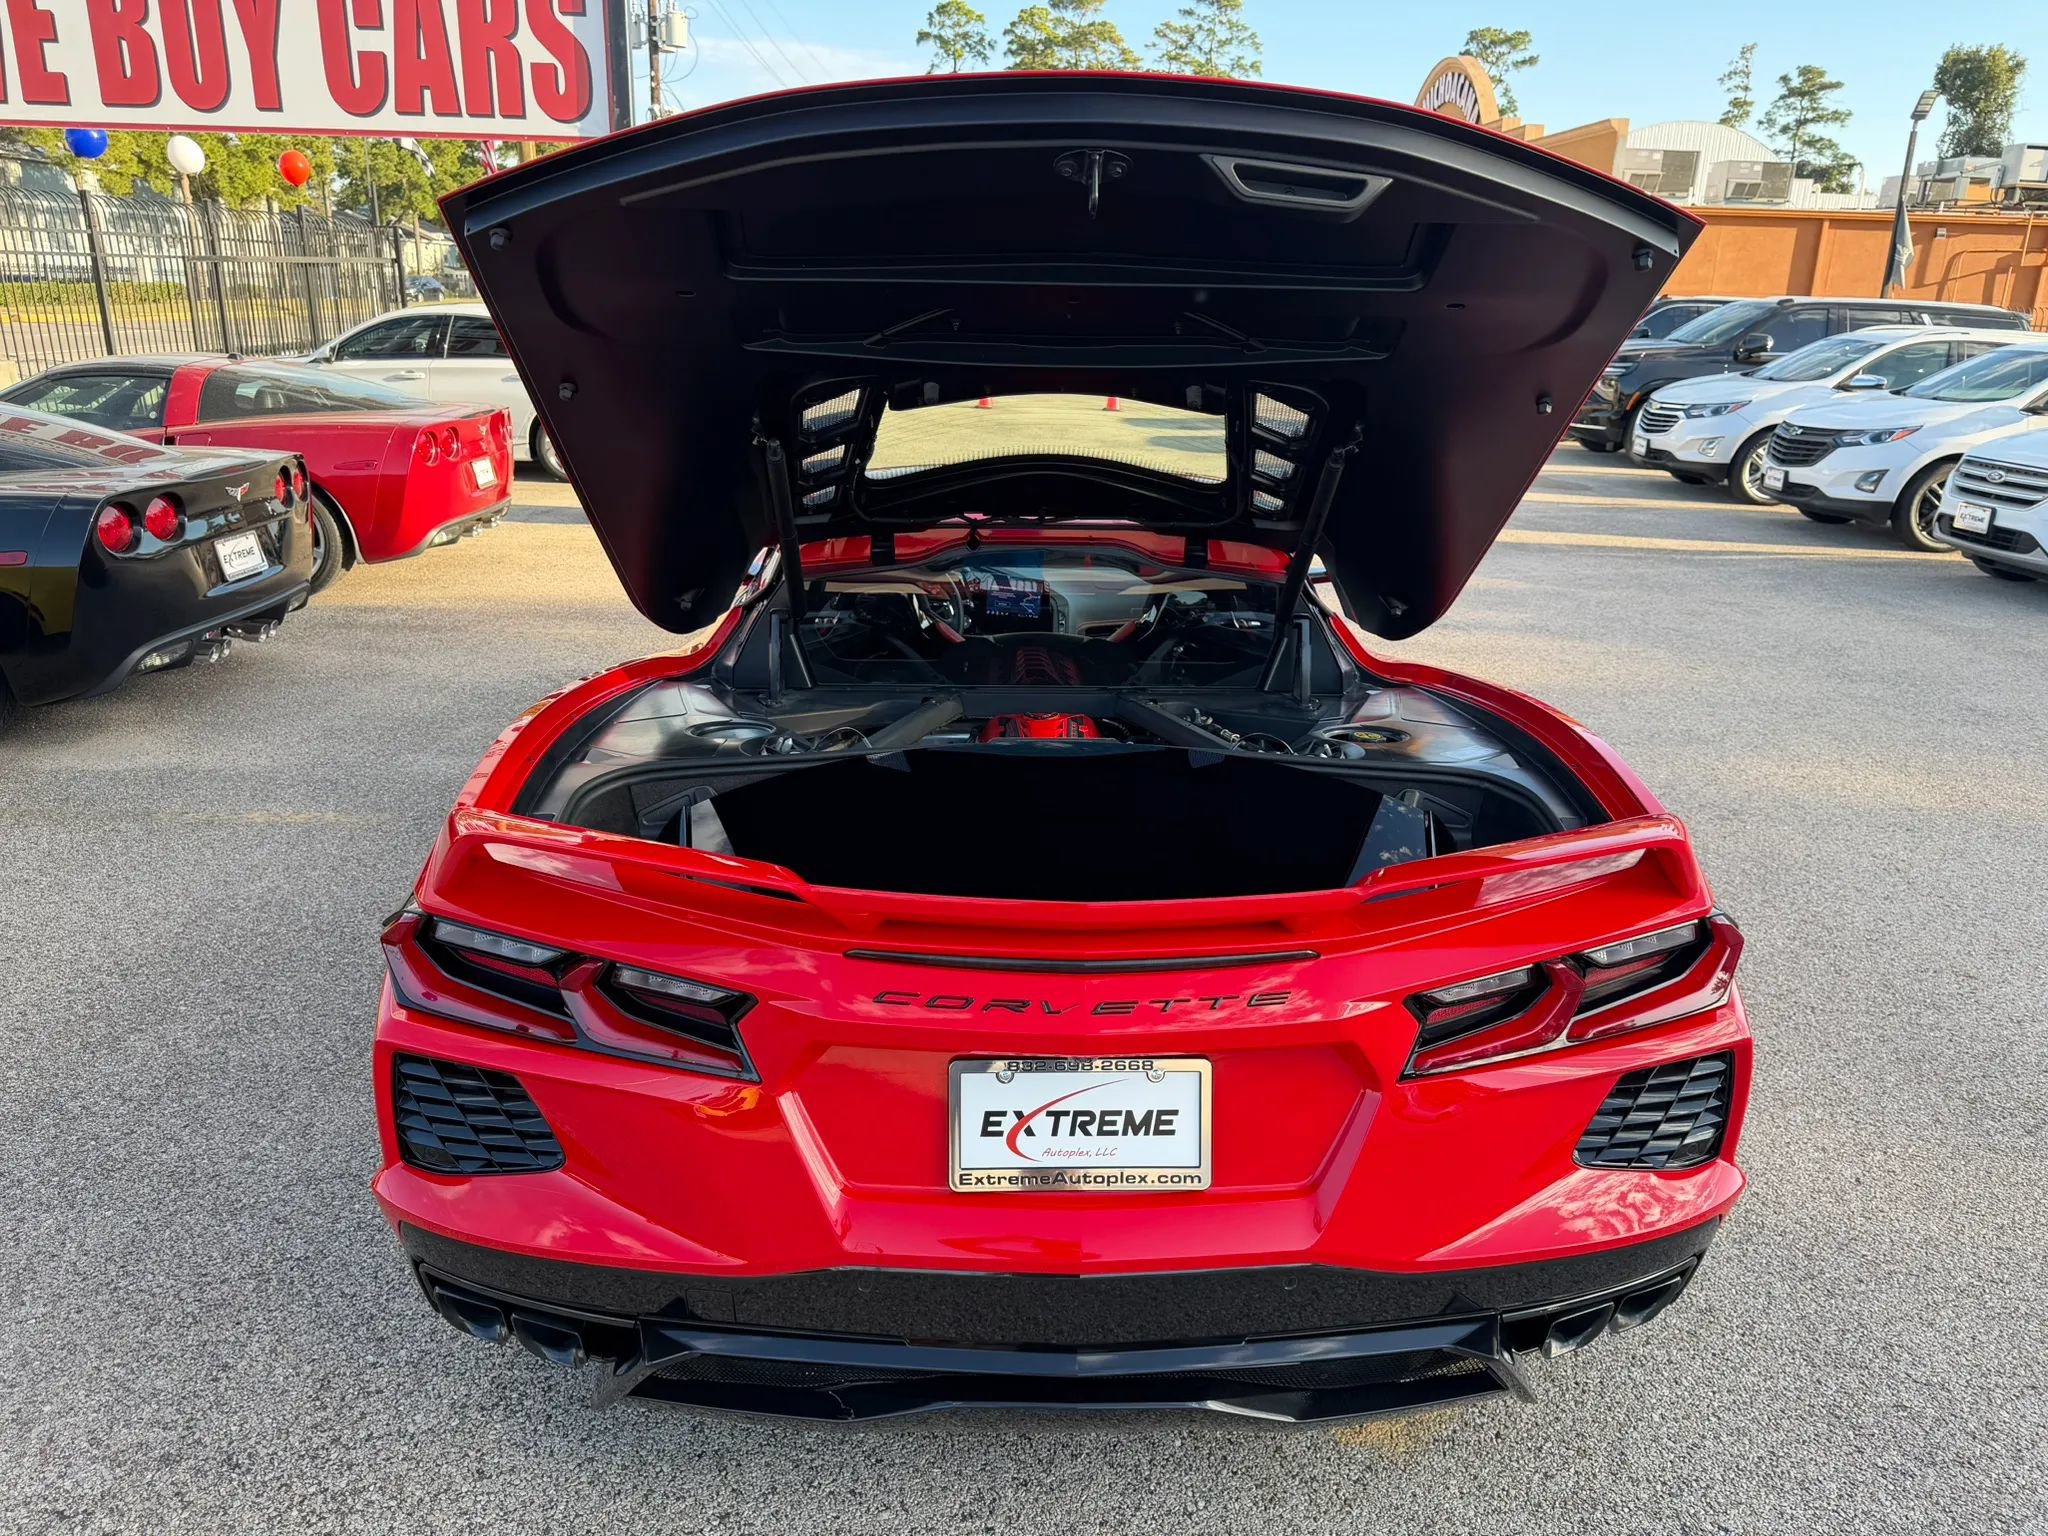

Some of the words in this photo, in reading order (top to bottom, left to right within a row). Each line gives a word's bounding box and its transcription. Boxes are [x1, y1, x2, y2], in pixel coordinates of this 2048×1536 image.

[90, 0, 284, 112] BUY
[317, 0, 593, 123] CARS
[223, 546, 255, 564] EXTREME
[872, 991, 1292, 1015] CORVETTE
[1007, 1060, 1154, 1072] 832-698-2668
[980, 1109, 1179, 1138] EXTREME
[1042, 1147, 1092, 1159] Autoplex,
[1095, 1147, 1118, 1157] LLC
[959, 1171, 1202, 1187] ExtremeAutoplex.com
